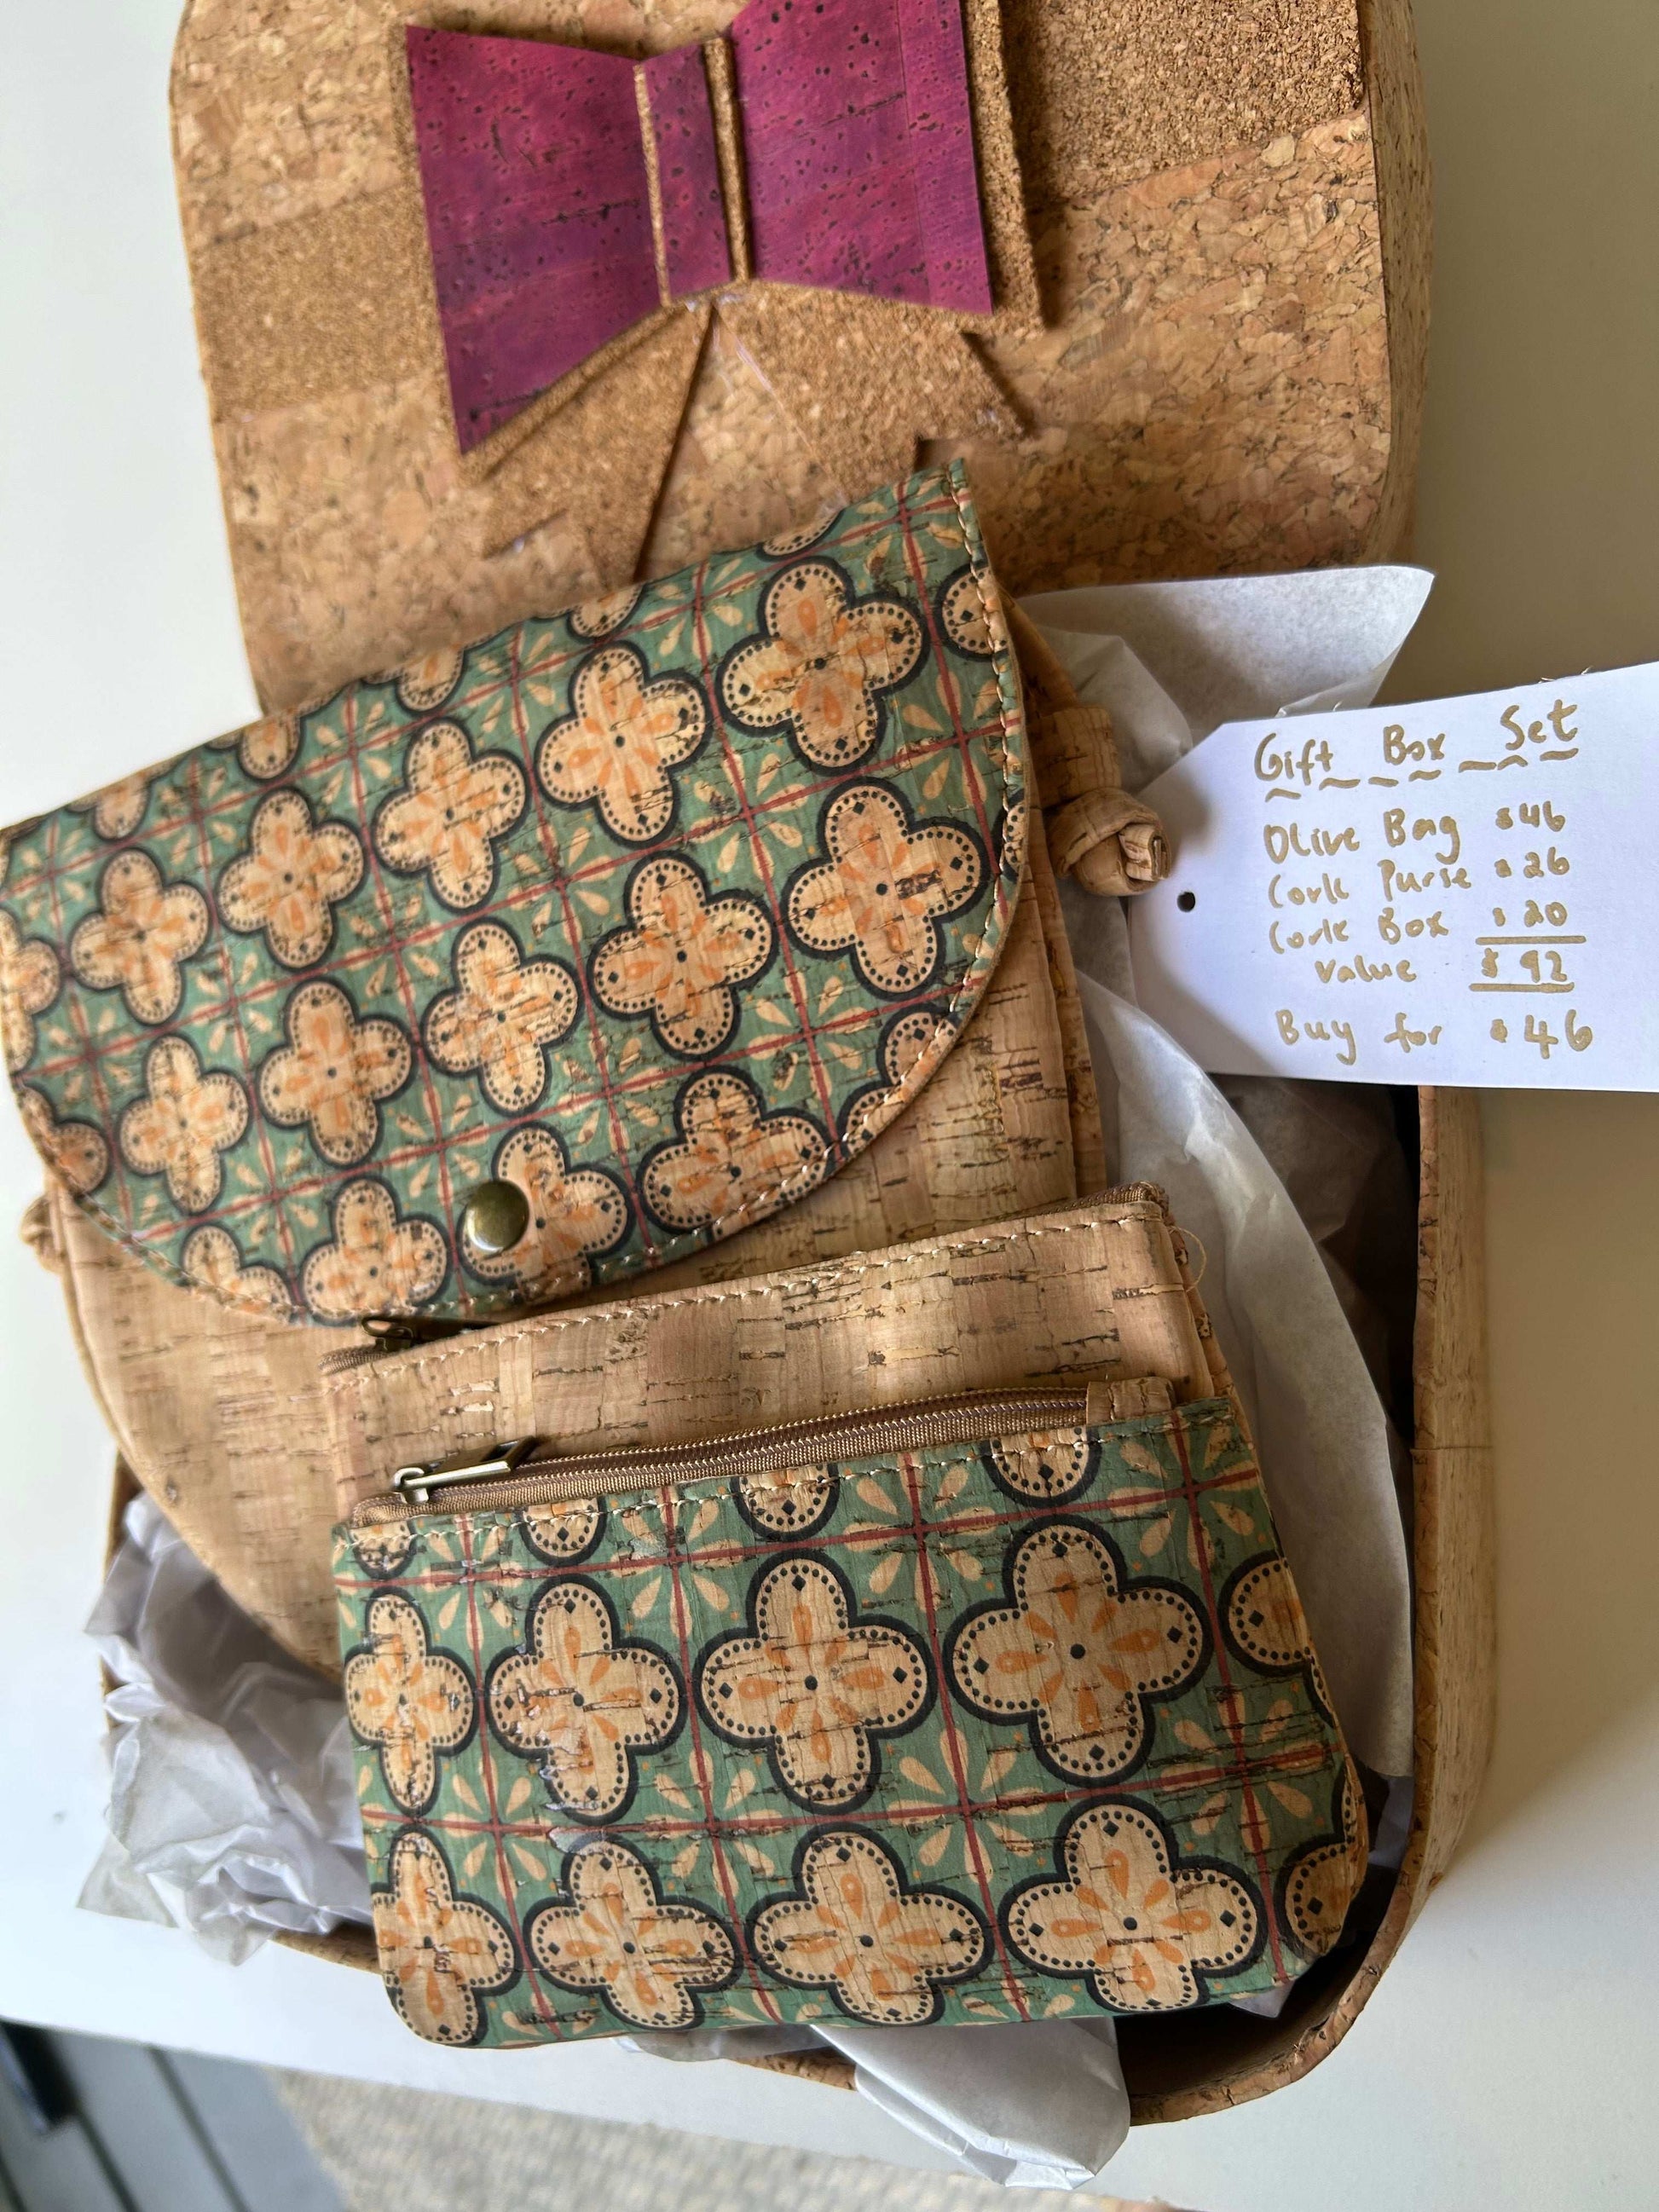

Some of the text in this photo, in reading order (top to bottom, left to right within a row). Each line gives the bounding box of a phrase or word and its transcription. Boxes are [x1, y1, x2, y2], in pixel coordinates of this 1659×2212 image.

[1254, 699, 1578, 786] Gift Box Set
[1263, 823, 1361, 863] Olive
[1384, 807, 1461, 865] Bag
[1269, 873, 1350, 908] Cork
[1378, 858, 1472, 901] Purse
[1269, 919, 1350, 955] Cork
[1379, 907, 1449, 944] Box
[1276, 1009, 1356, 1066] Buy
[1384, 1012, 1442, 1054] for
